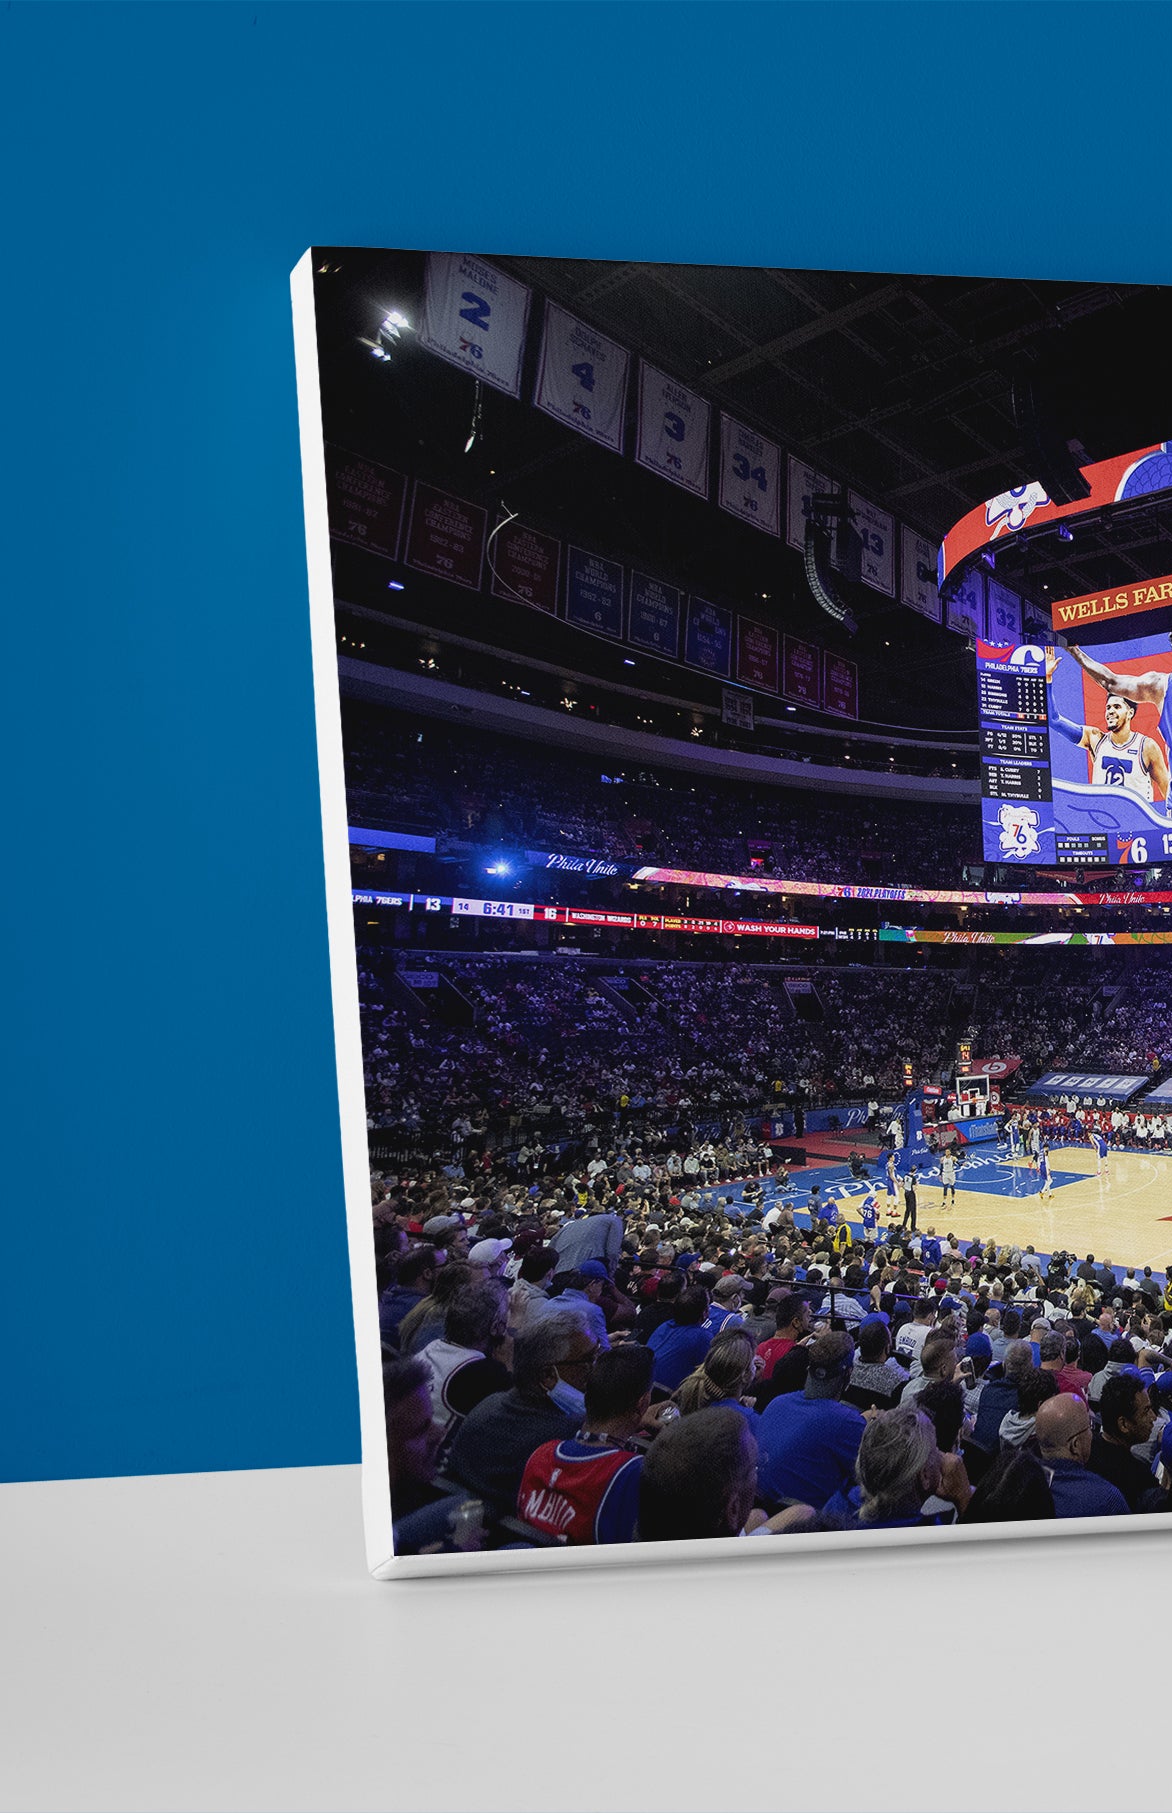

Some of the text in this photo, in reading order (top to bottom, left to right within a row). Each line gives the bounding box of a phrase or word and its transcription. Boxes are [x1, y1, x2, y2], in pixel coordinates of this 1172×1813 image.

[459, 291, 491, 332] 2
[459, 336, 483, 359] 76
[572, 362, 595, 392] 4
[572, 400, 591, 420] 76
[664, 411, 685, 442] 3
[666, 451, 682, 470] 76
[733, 452, 767, 492] 34
[743, 496, 758, 511] 76
[348, 520, 368, 537] 76
[861, 528, 883, 557] 13
[435, 554, 454, 570] 76
[1058, 594, 1128, 623] WELLS
[996, 608, 1017, 632] 32
[985, 662, 1019, 672] PHILADELPHIA
[1012, 824, 1027, 844] 76
[1117, 836, 1148, 864] 76
[547, 853, 619, 876] Phila Unite
[376, 896, 402, 905] 76ERS
[856, 888, 873, 898] 2021
[873, 888, 906, 900] PLAYOFFS
[1098, 892, 1146, 905] Phila Unite
[426, 898, 441, 911] 13
[458, 902, 469, 910] 14
[482, 903, 514, 916] 6:41
[544, 907, 557, 920] 16
[572, 912, 606, 921] WASHINGTON
[736, 924, 762, 932] WASH
[764, 926, 786, 934] YOUR
[788, 926, 816, 936] HANDS
[943, 931, 996, 944] Phila Unite
[863, 1210, 872, 1218] 76
[522, 1488, 576, 1530] MBIID
